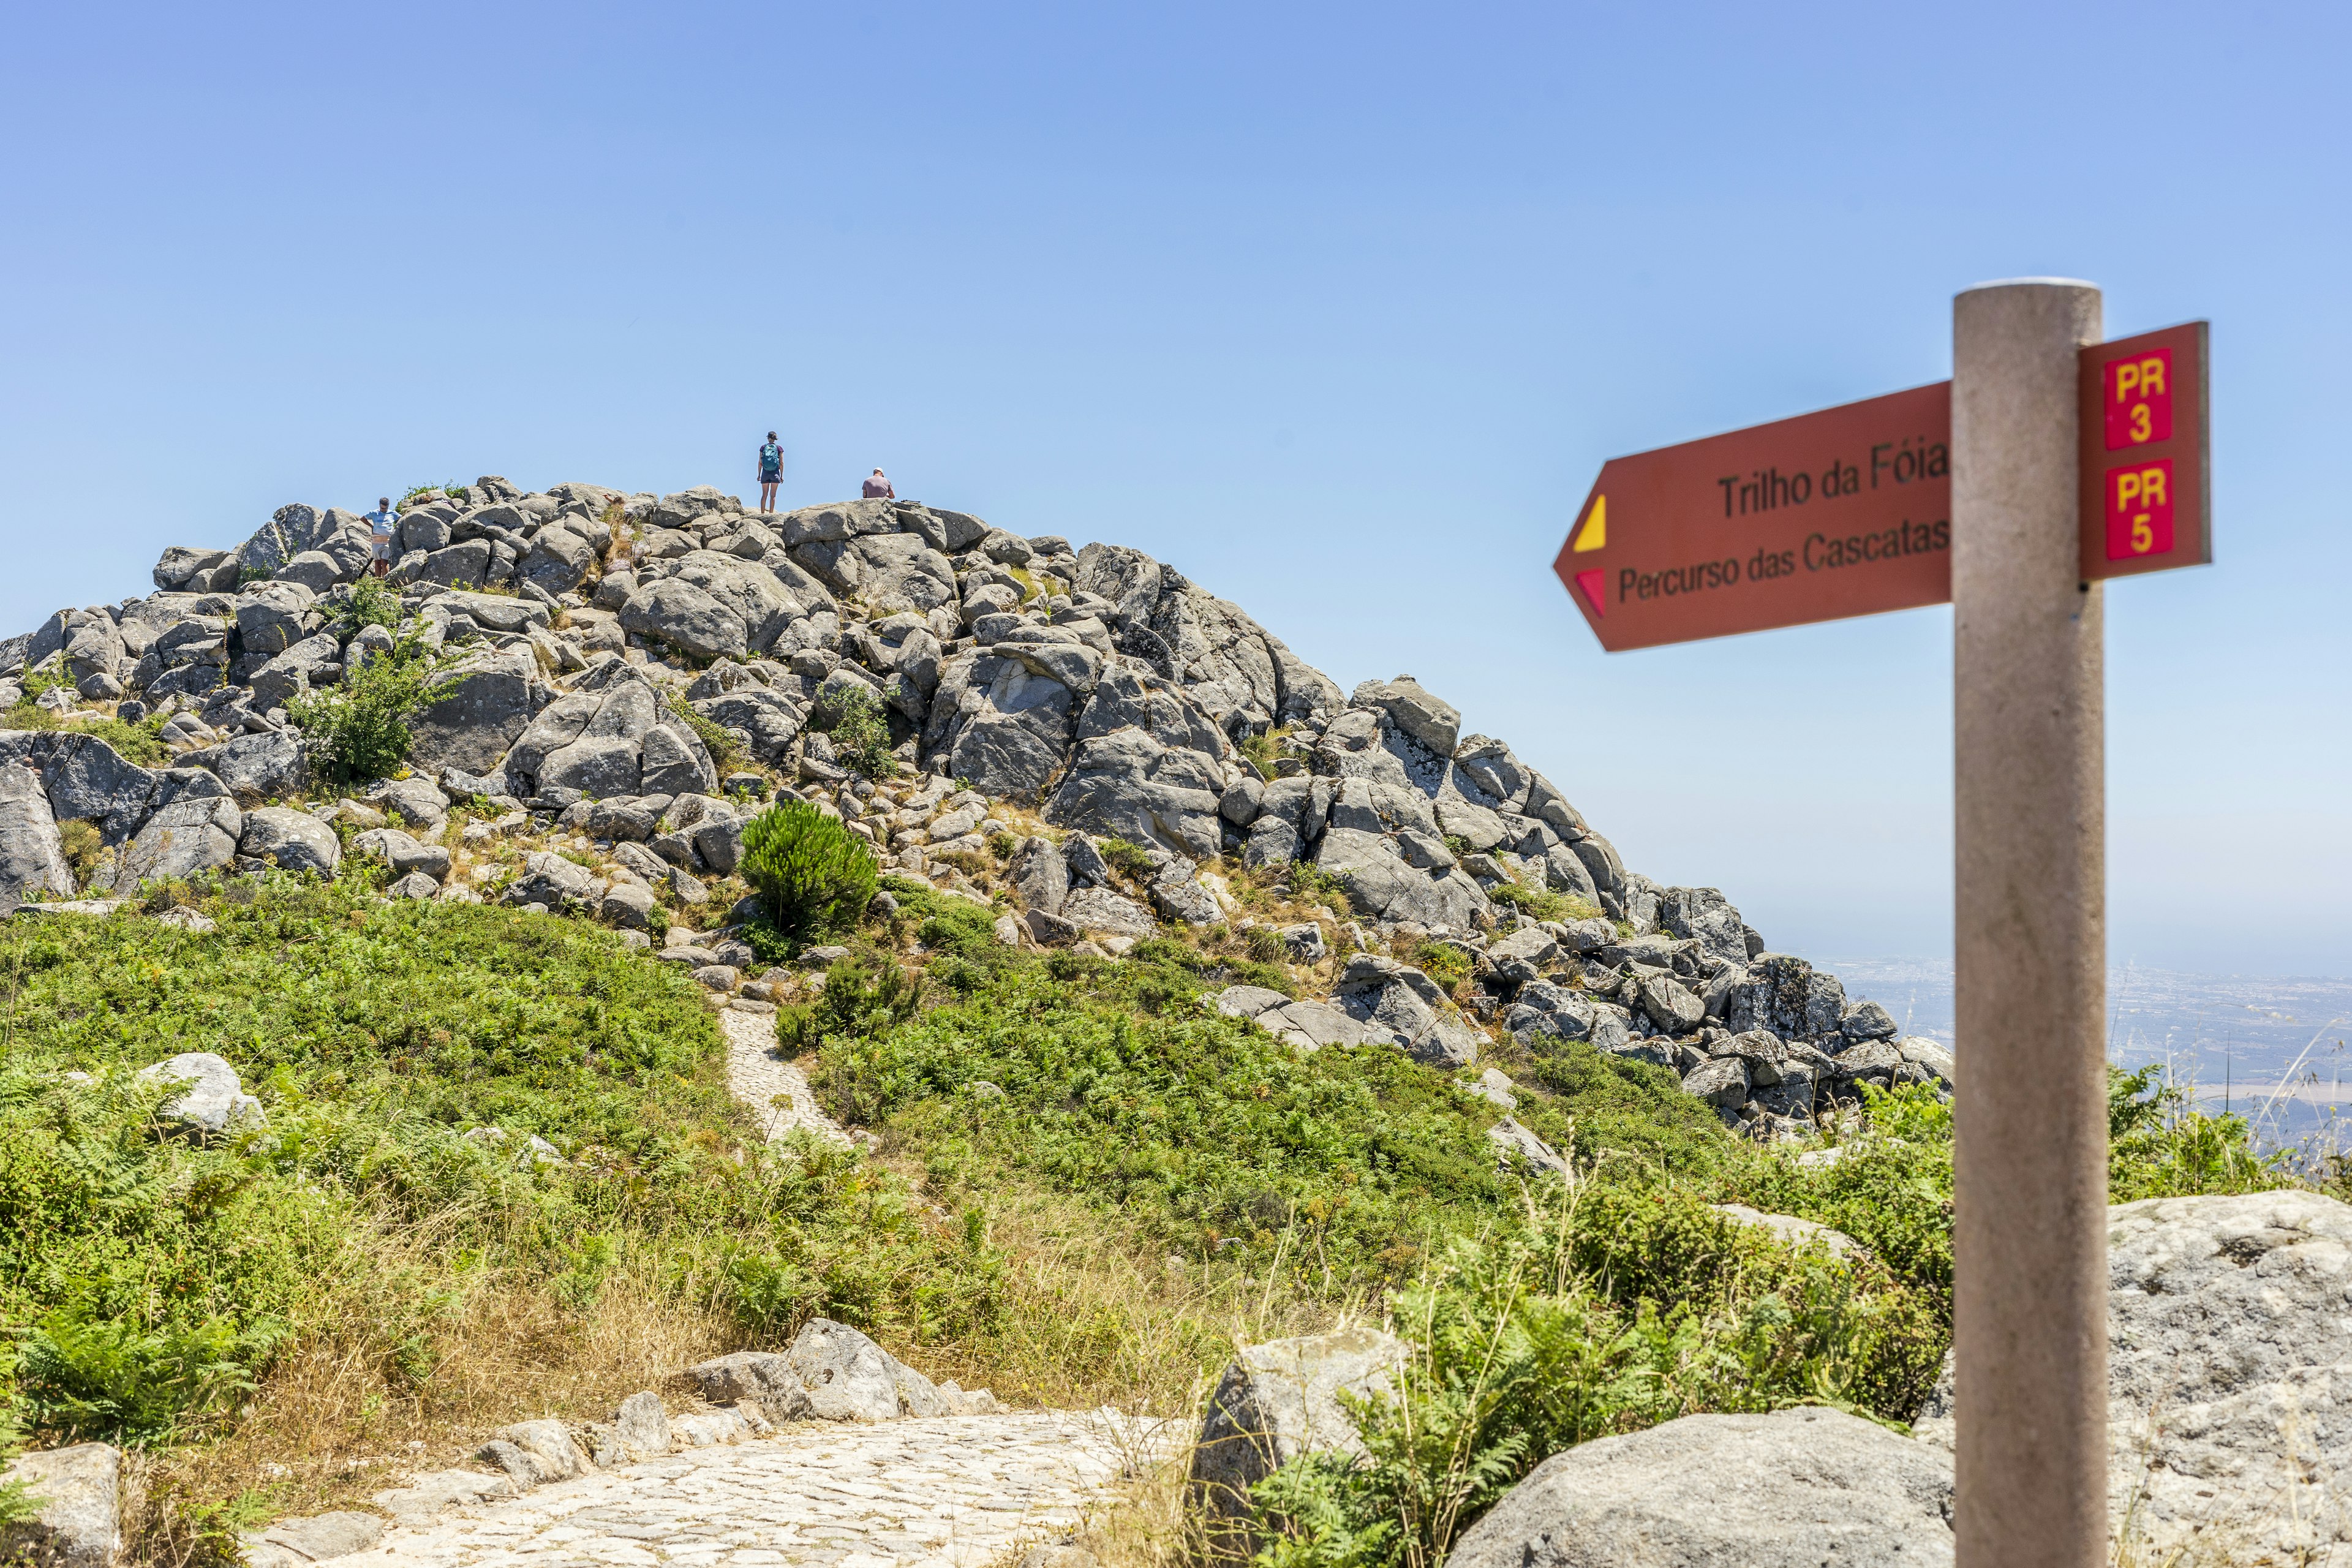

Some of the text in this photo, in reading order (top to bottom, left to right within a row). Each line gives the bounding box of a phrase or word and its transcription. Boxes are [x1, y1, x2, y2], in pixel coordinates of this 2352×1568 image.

[2116, 357, 2165, 403] PR
[2129, 403, 2152, 442] 3
[1719, 435, 1950, 518] Trilho da Fóia
[2117, 468, 2166, 513] PR
[2130, 513, 2153, 554] 5
[1619, 519, 1950, 603] Percurso das Cascatas
